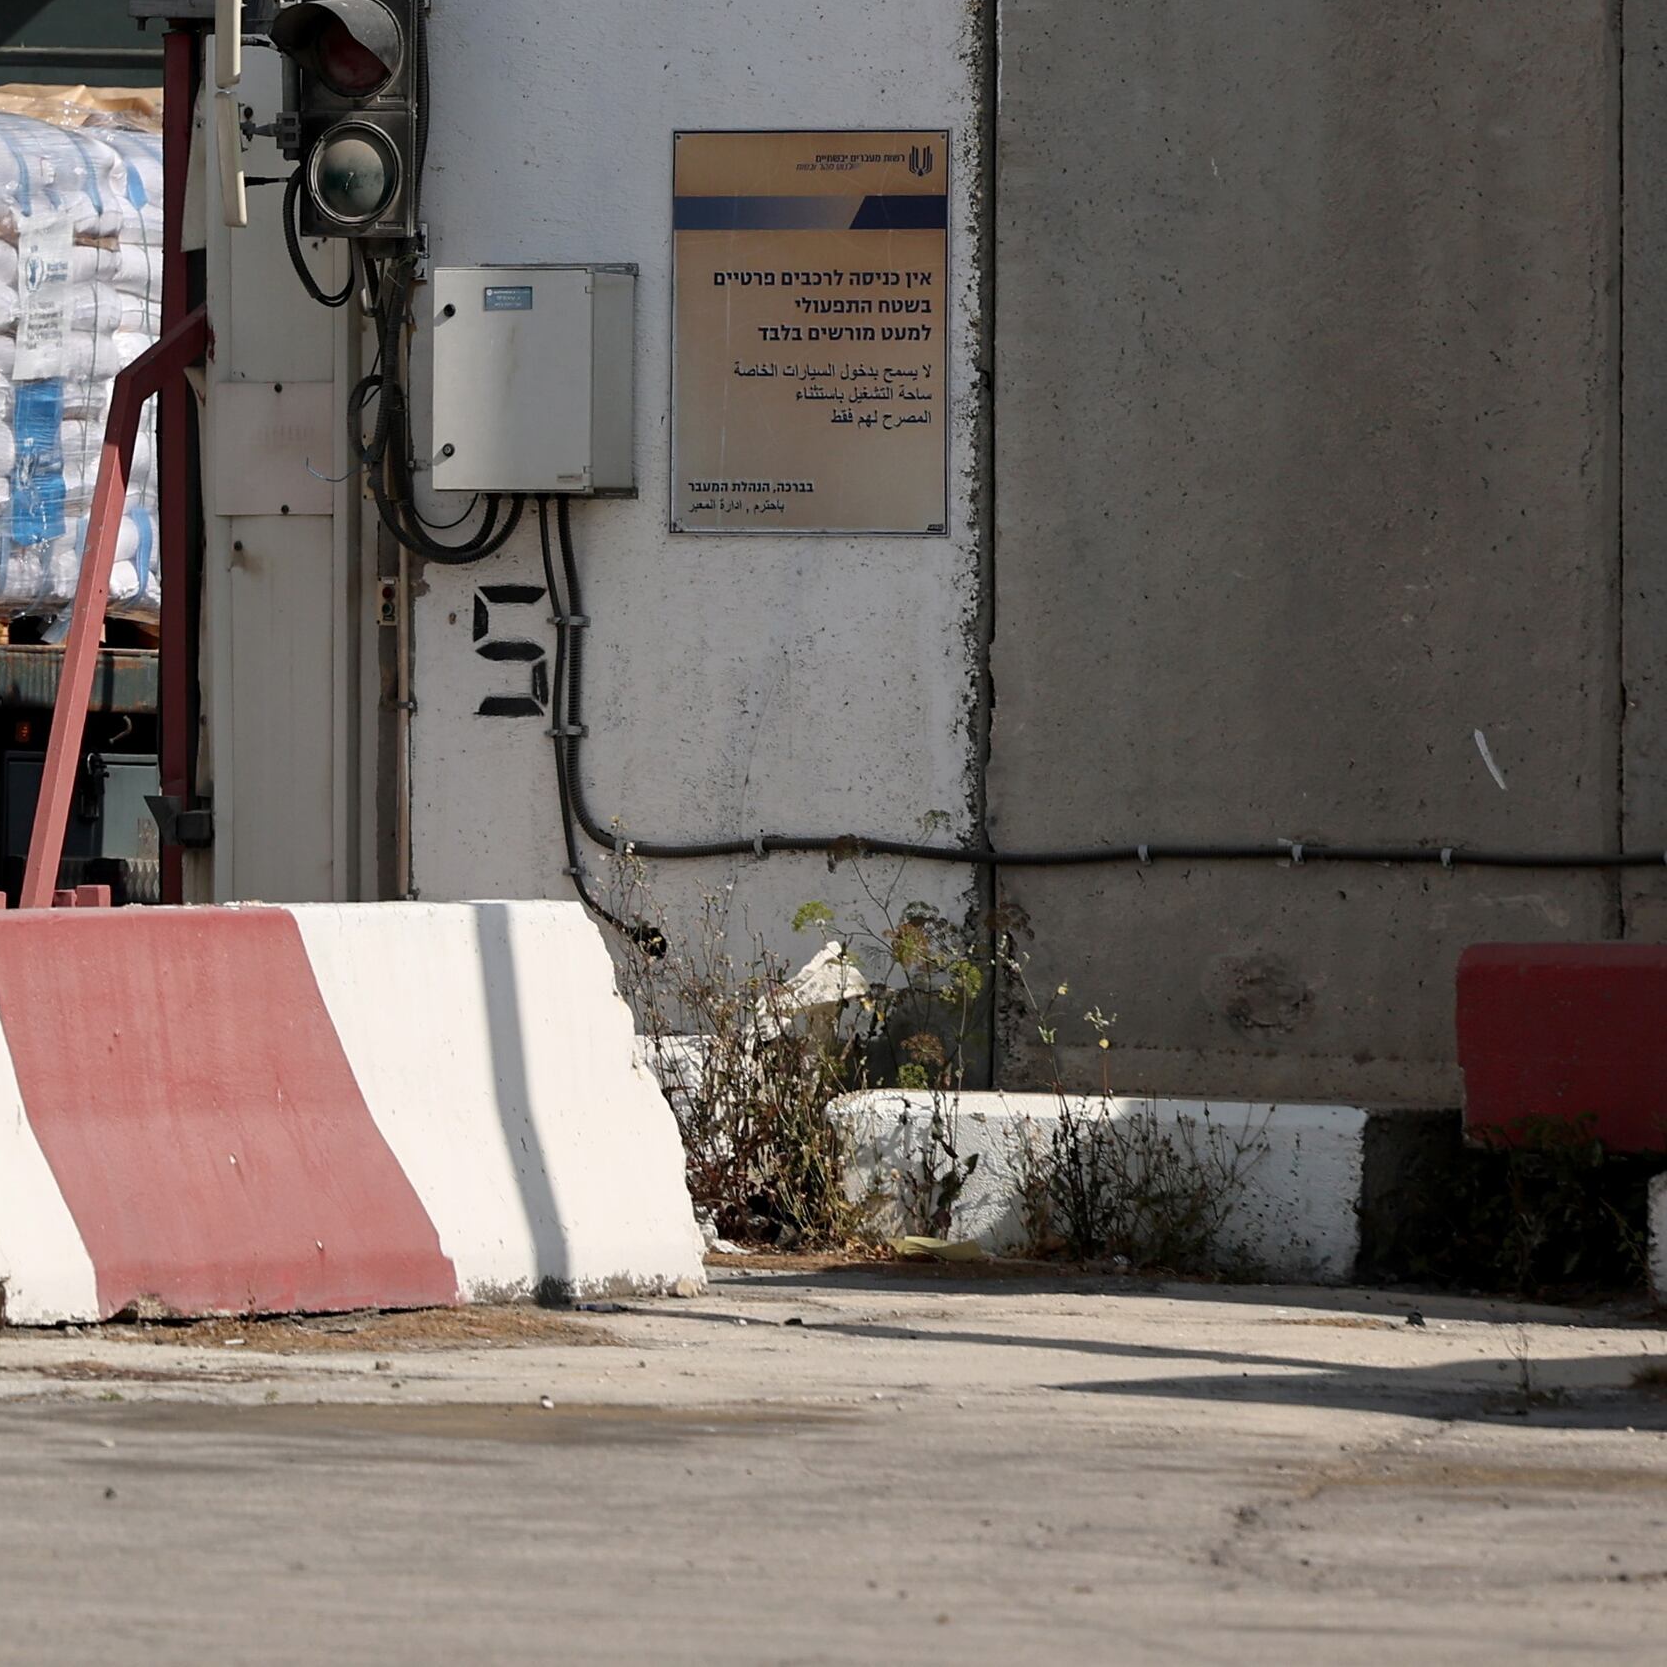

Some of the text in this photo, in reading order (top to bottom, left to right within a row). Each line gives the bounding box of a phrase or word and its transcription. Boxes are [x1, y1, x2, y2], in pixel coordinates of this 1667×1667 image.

[815, 154, 849, 164] יבשתיים
[850, 154, 882, 163] מעברים
[713, 269, 932, 289] אין כניסה לרכבים פרטיים
[794, 296, 932, 314] בשטח התפעולי
[757, 323, 932, 341] למעט מורשים בלבד
[733, 361, 932, 384] لا يسمح بدخول السيارات الخاصة
[848, 385, 894, 404] التشغيل
[830, 408, 932, 430] المصرح لهم فقط
[688, 481, 729, 493] המעבר
[731, 480, 770, 493] הנהלת
